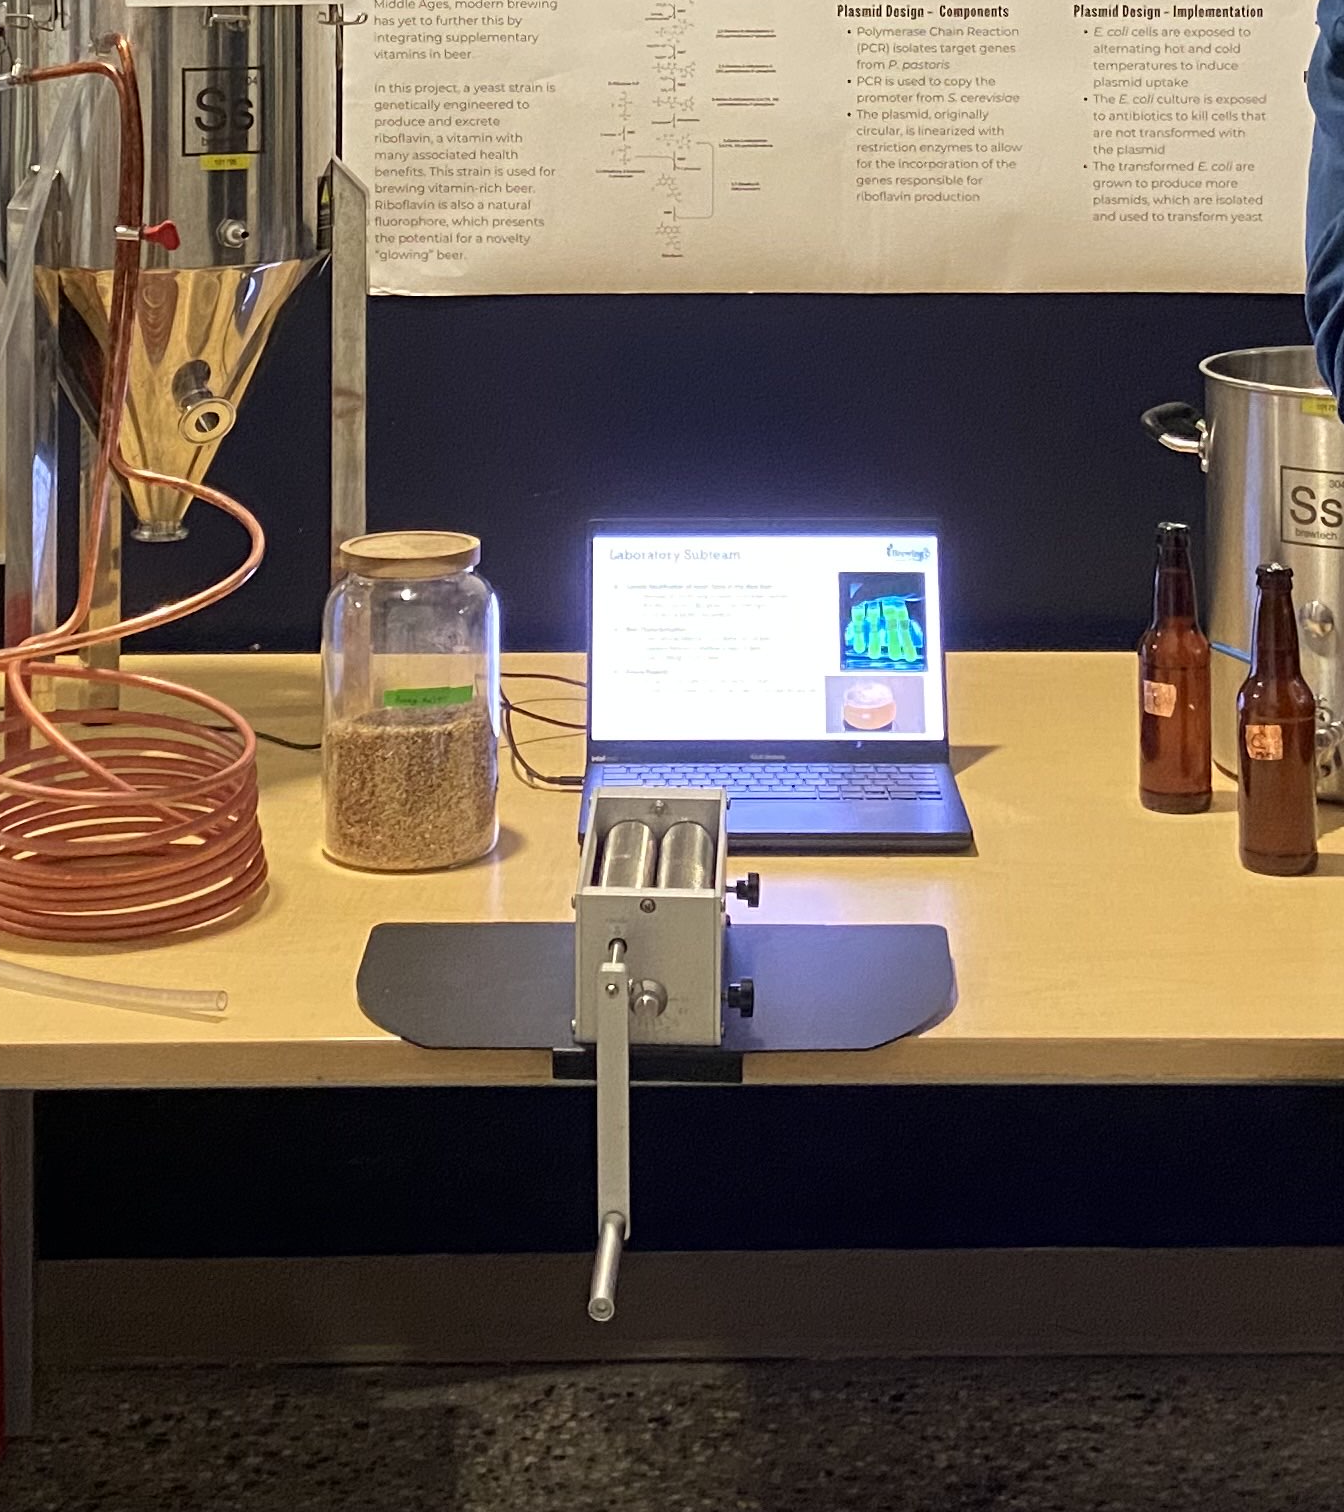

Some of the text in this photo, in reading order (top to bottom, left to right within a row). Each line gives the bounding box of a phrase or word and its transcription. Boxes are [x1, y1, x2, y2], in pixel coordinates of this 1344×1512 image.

[838, 5, 1008, 20] Plasmid Design Components
[1074, 5, 1263, 20] Plasmid Design Implementation
[857, 26, 1019, 39] Polymerase Chain Reaction
[1290, 485, 1343, 528] Ss
[1295, 527, 1338, 540] brewtech
[609, 549, 741, 565] Laboratory Subteam
